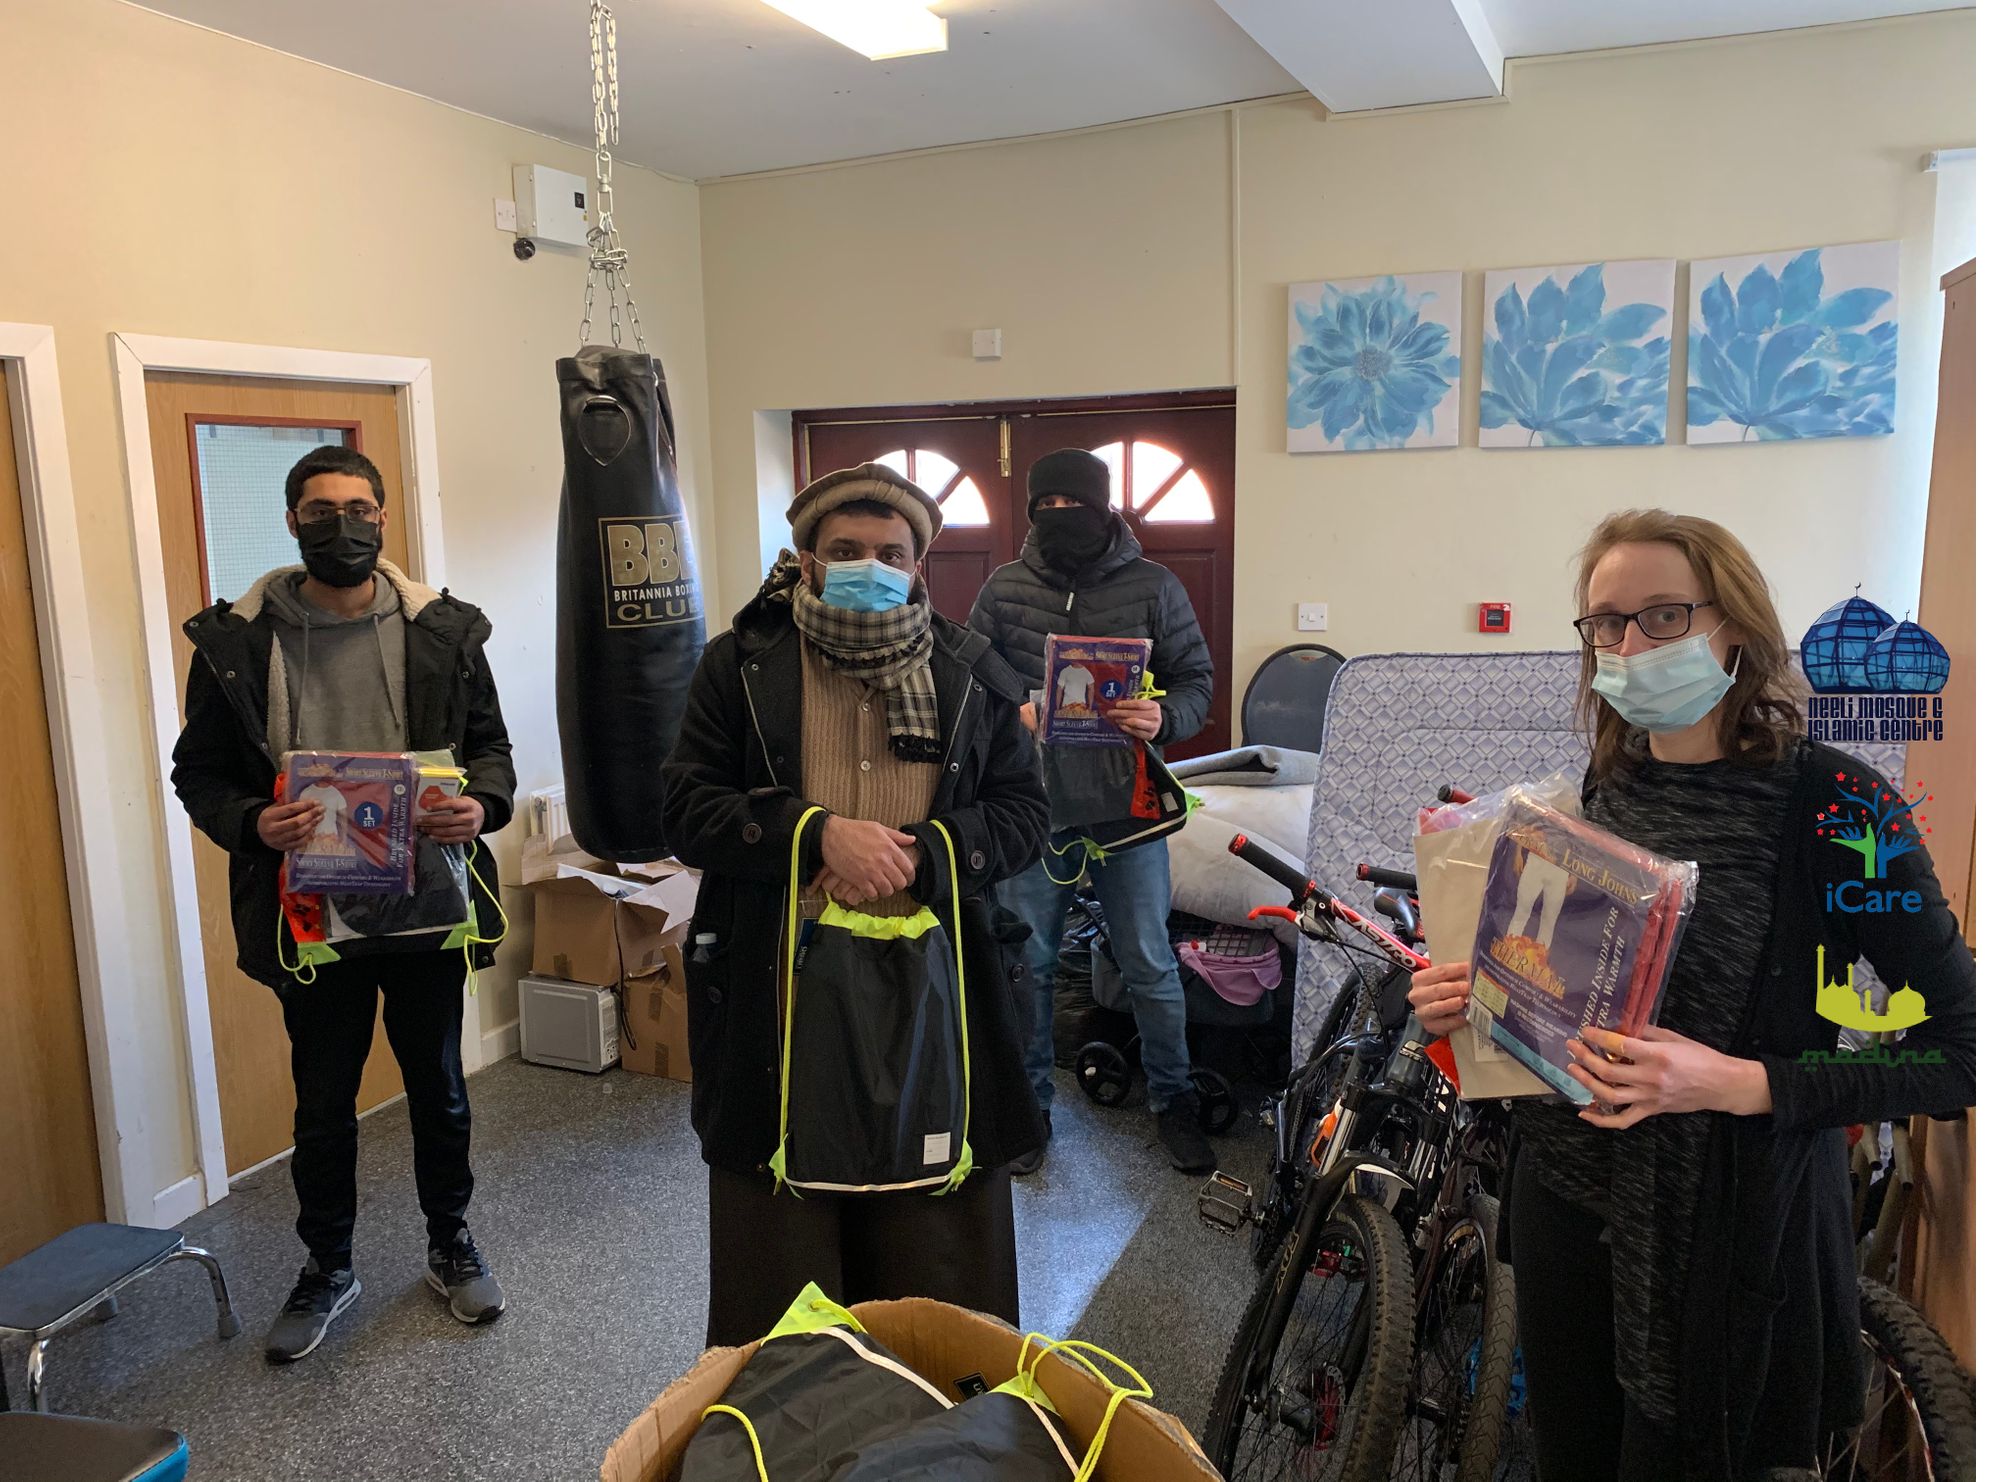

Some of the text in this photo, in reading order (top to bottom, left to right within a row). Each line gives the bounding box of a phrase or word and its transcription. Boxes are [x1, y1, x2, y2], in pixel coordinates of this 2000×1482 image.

[614, 588, 672, 602] BRITANNIA
[1108, 682, 1115, 692] 1
[363, 806, 375, 820] 1
[362, 820, 376, 828] SET
[1562, 848, 1639, 906] LONG JOHNS
[1591, 938, 1611, 991] INSIDE
[1603, 906, 1620, 940] FOR
[1603, 935, 1626, 997] WARMTH
